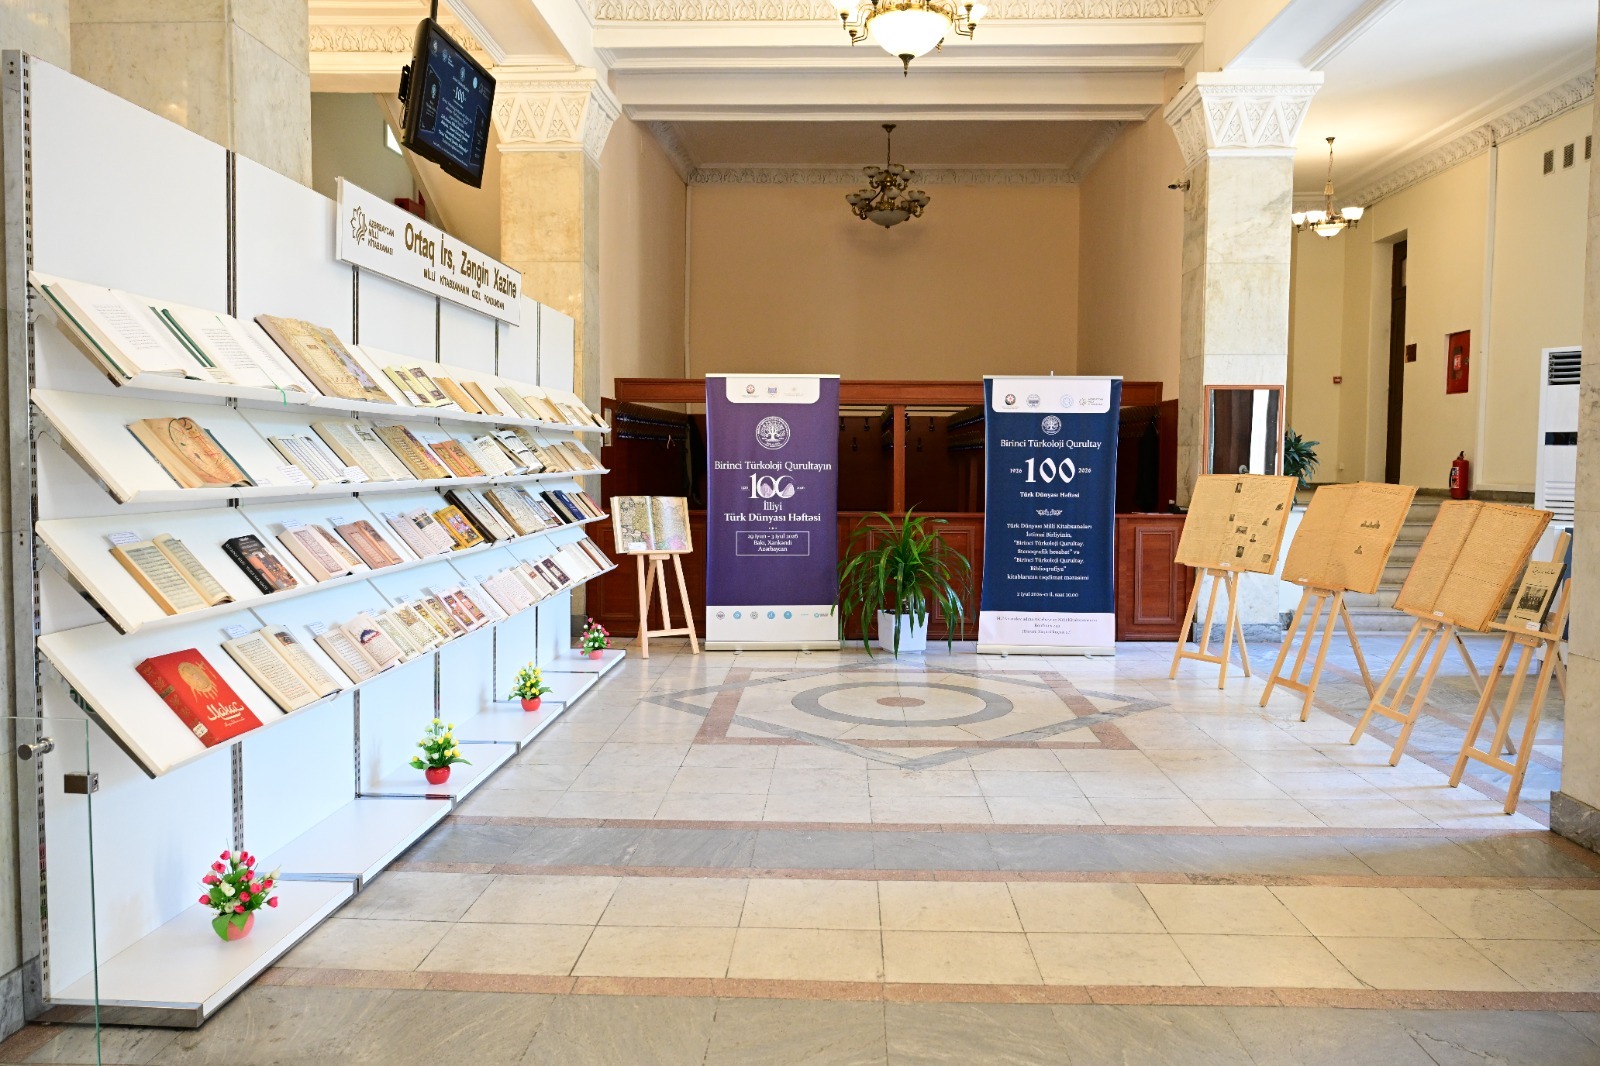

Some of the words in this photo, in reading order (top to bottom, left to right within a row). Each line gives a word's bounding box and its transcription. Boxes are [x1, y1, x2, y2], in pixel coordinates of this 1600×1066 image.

[404, 222, 434, 267] Ortaq
[440, 233, 456, 275] İrs,
[460, 251, 489, 289] Zəngin
[494, 267, 517, 299] Xəzinə
[423, 268, 436, 282] MİLLİ
[1000, 440, 1026, 448] Birinci
[1028, 440, 1064, 450] Türkoloji
[1066, 440, 1102, 450] Qurultay
[714, 460, 742, 470] Birinci
[745, 460, 782, 472] Türkoloji
[784, 460, 832, 472] Qurultayın
[1025, 458, 1076, 484] 100
[763, 500, 782, 512] İlliyi
[724, 512, 746, 522] Türk
[748, 512, 786, 523] Dünyası
[788, 512, 821, 522] Həftəsi
